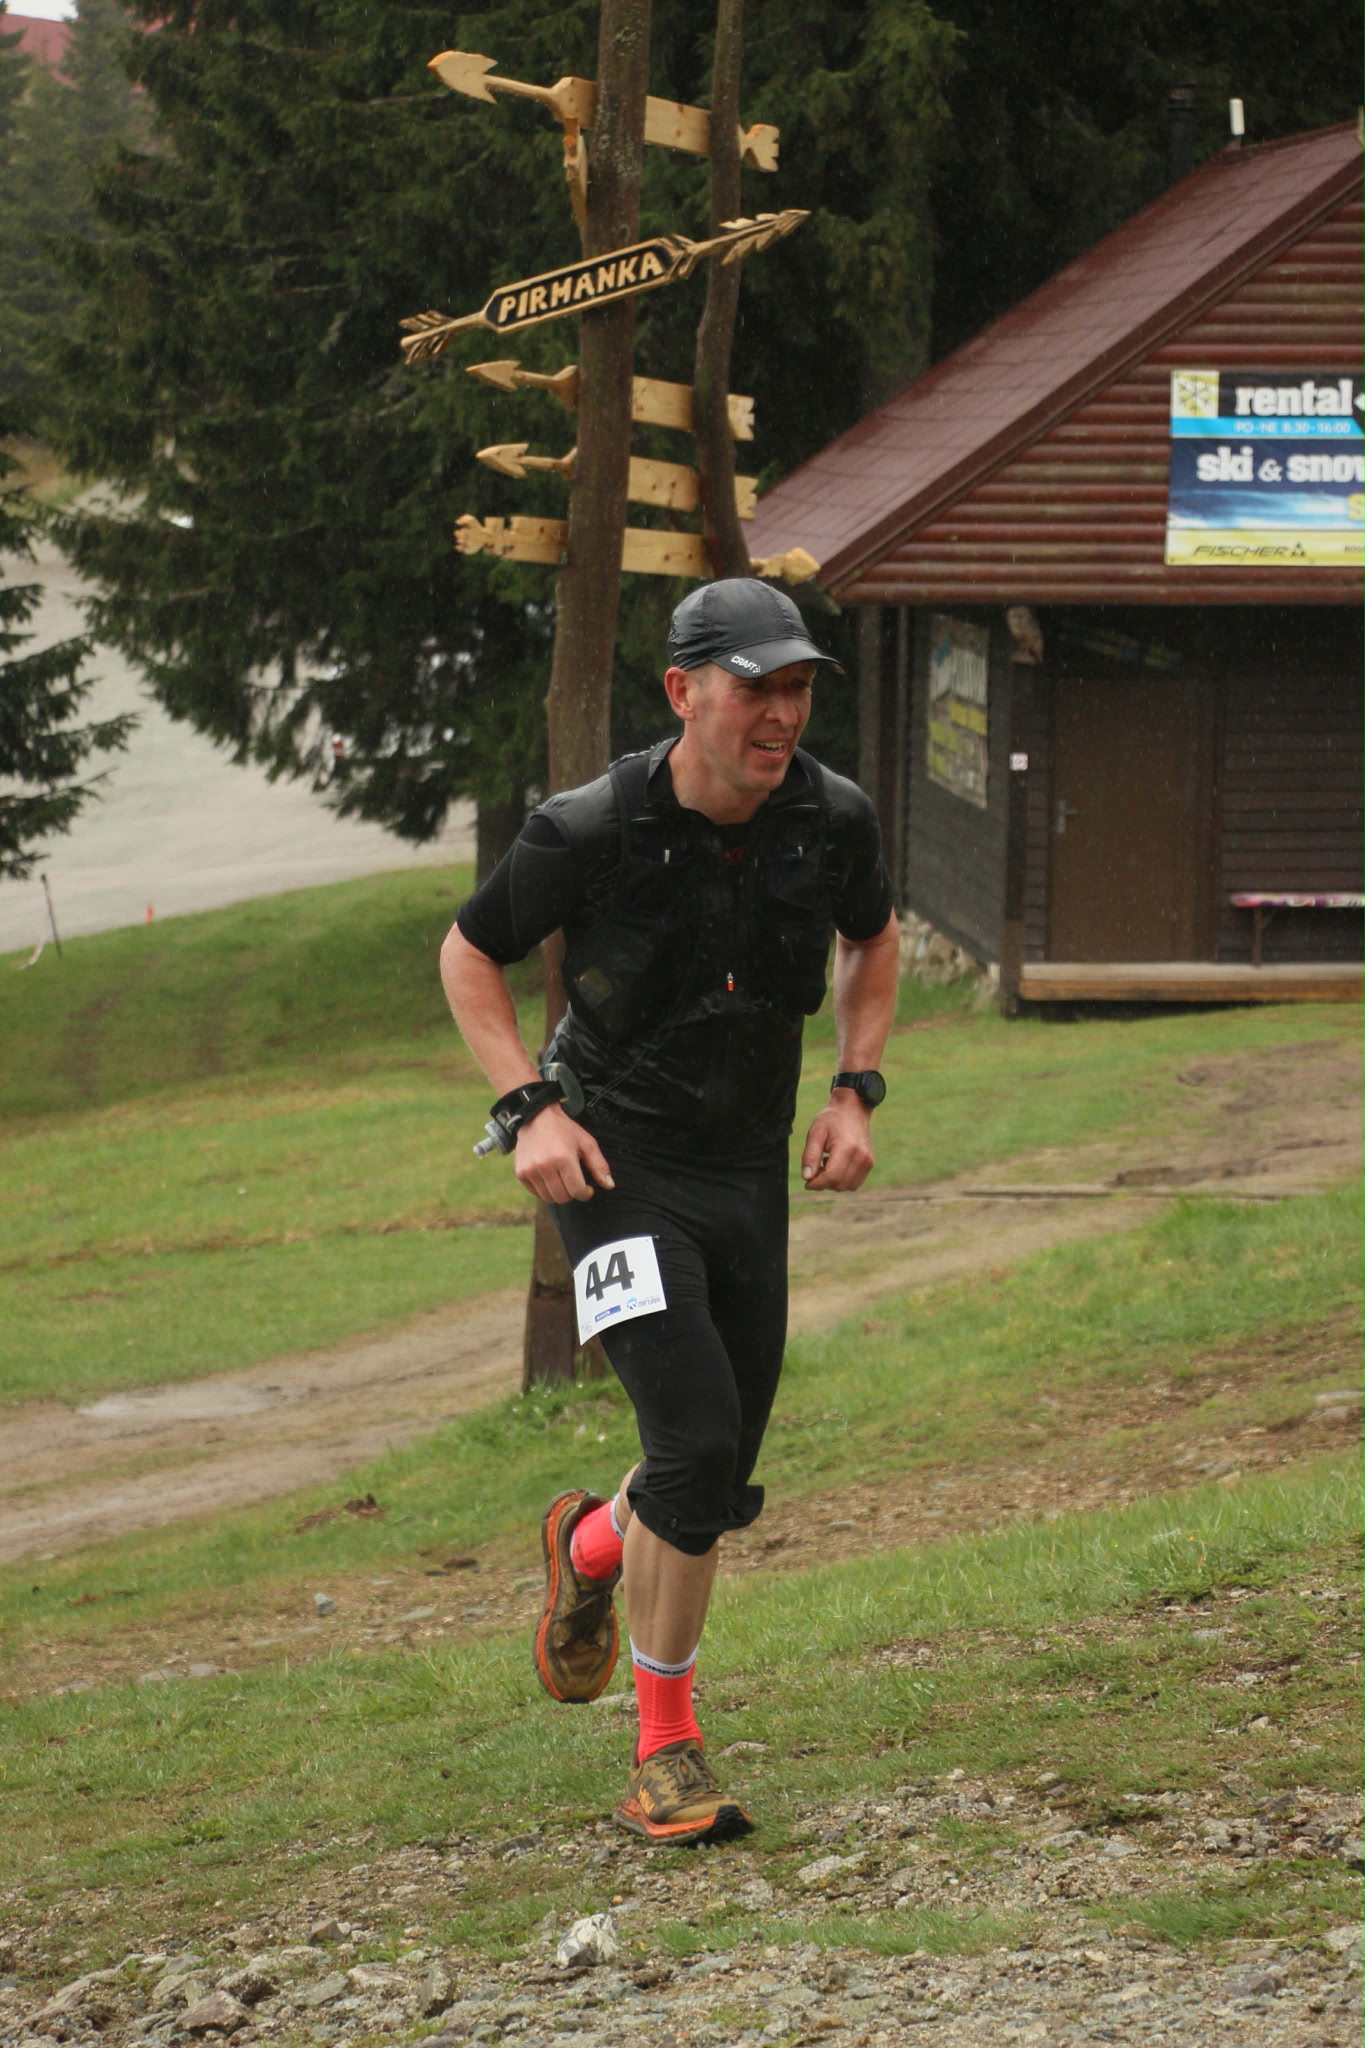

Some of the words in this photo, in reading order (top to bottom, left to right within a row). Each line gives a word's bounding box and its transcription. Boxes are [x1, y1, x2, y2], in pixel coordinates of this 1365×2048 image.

[498, 251, 665, 323] PIRMANKA
[1235, 378, 1354, 416] rental
[1197, 446, 1253, 482] ski
[1257, 459, 1283, 482] &
[1193, 545, 1288, 558] FISCHER
[731, 655, 757, 671] CRAFT
[585, 1250, 635, 1302] 44
